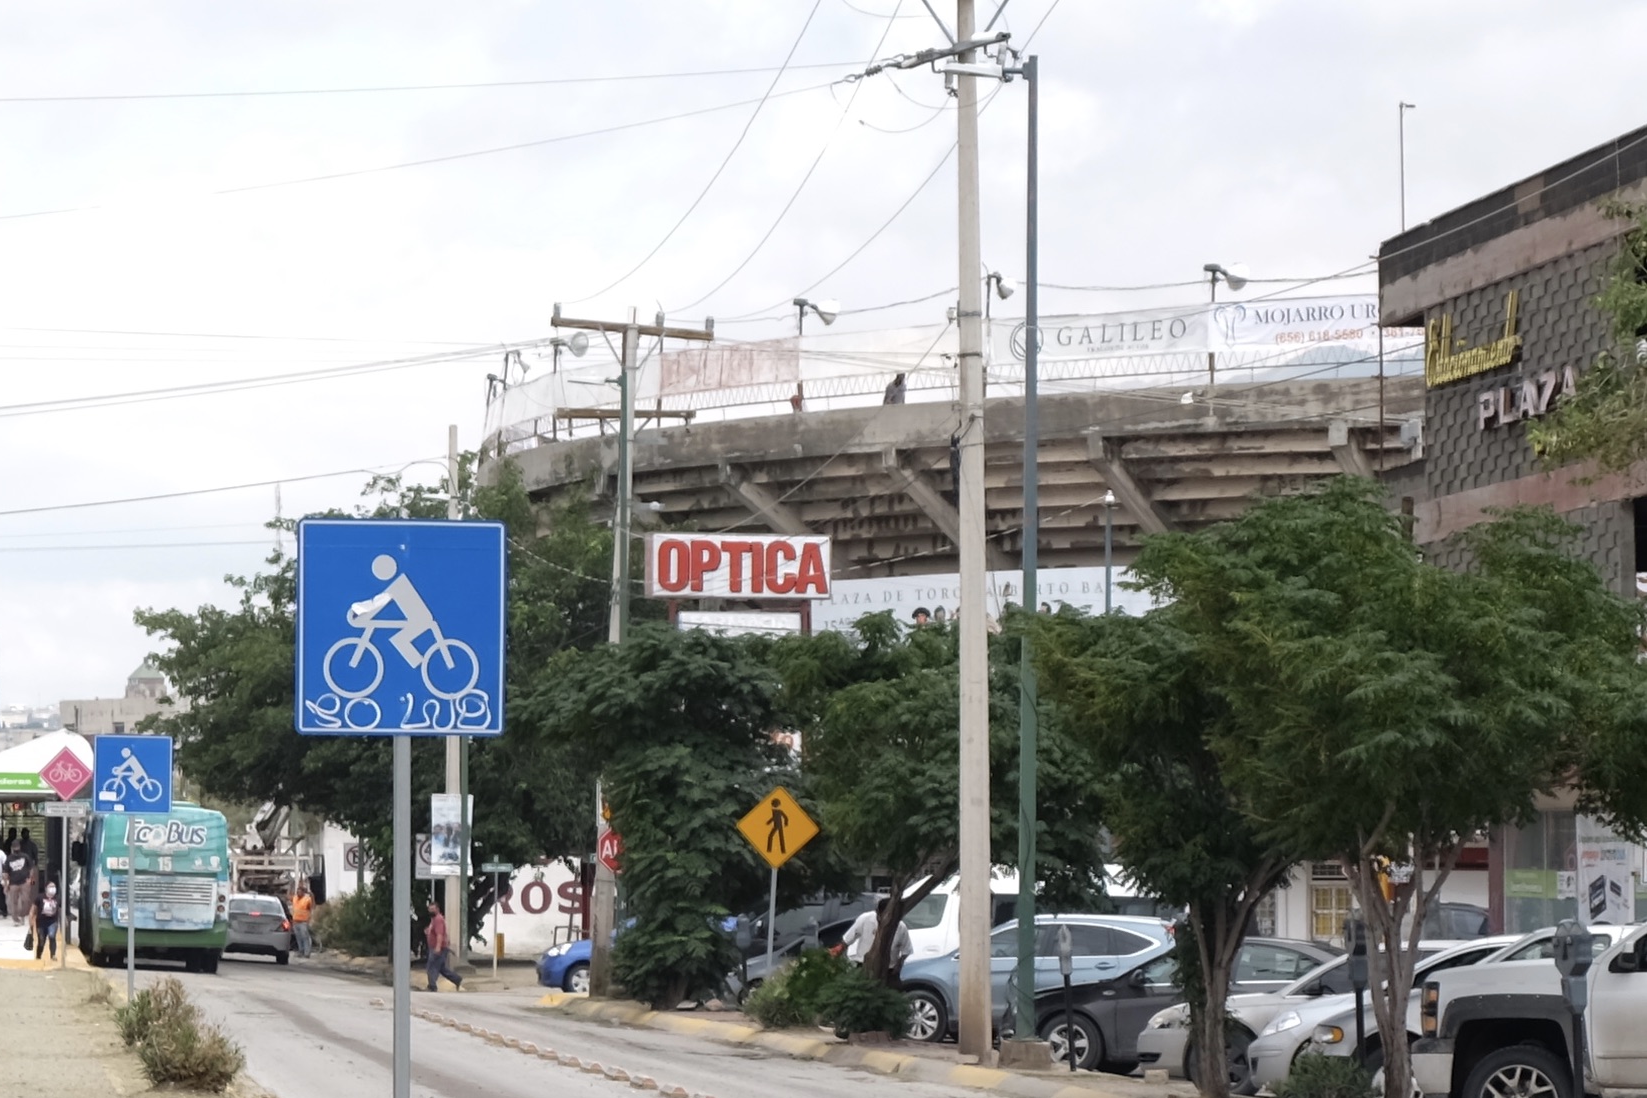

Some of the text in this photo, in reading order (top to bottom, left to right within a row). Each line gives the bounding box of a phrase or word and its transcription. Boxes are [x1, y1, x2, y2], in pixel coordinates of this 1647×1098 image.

[1255, 304, 1345, 326] MOJARRO
[1057, 319, 1187, 347] GALILEO
[1479, 364, 1580, 430] PLAZA
[658, 539, 829, 594] OPTICA
[883, 590, 904, 603] DE
[158, 856, 172, 871] 15
